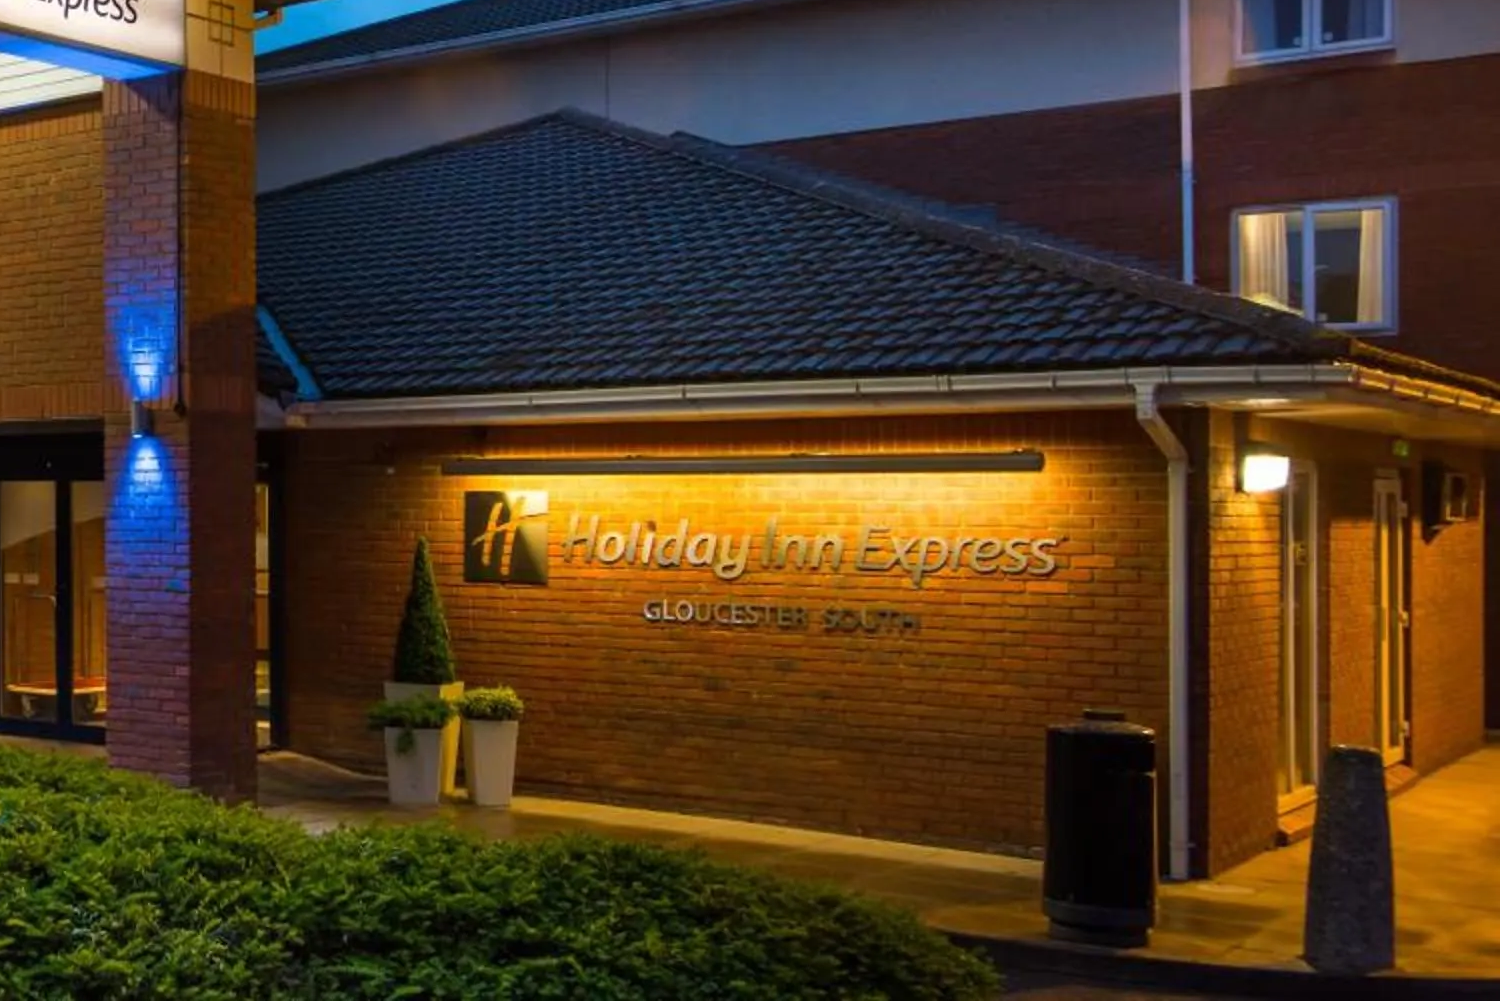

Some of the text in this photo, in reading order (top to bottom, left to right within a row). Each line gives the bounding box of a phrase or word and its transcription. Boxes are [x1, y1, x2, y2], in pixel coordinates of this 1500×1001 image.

[561, 509, 750, 580] Holiday
[759, 514, 844, 572] Inn
[855, 524, 1058, 590] Express
[642, 598, 807, 630] GLOUCESTER
